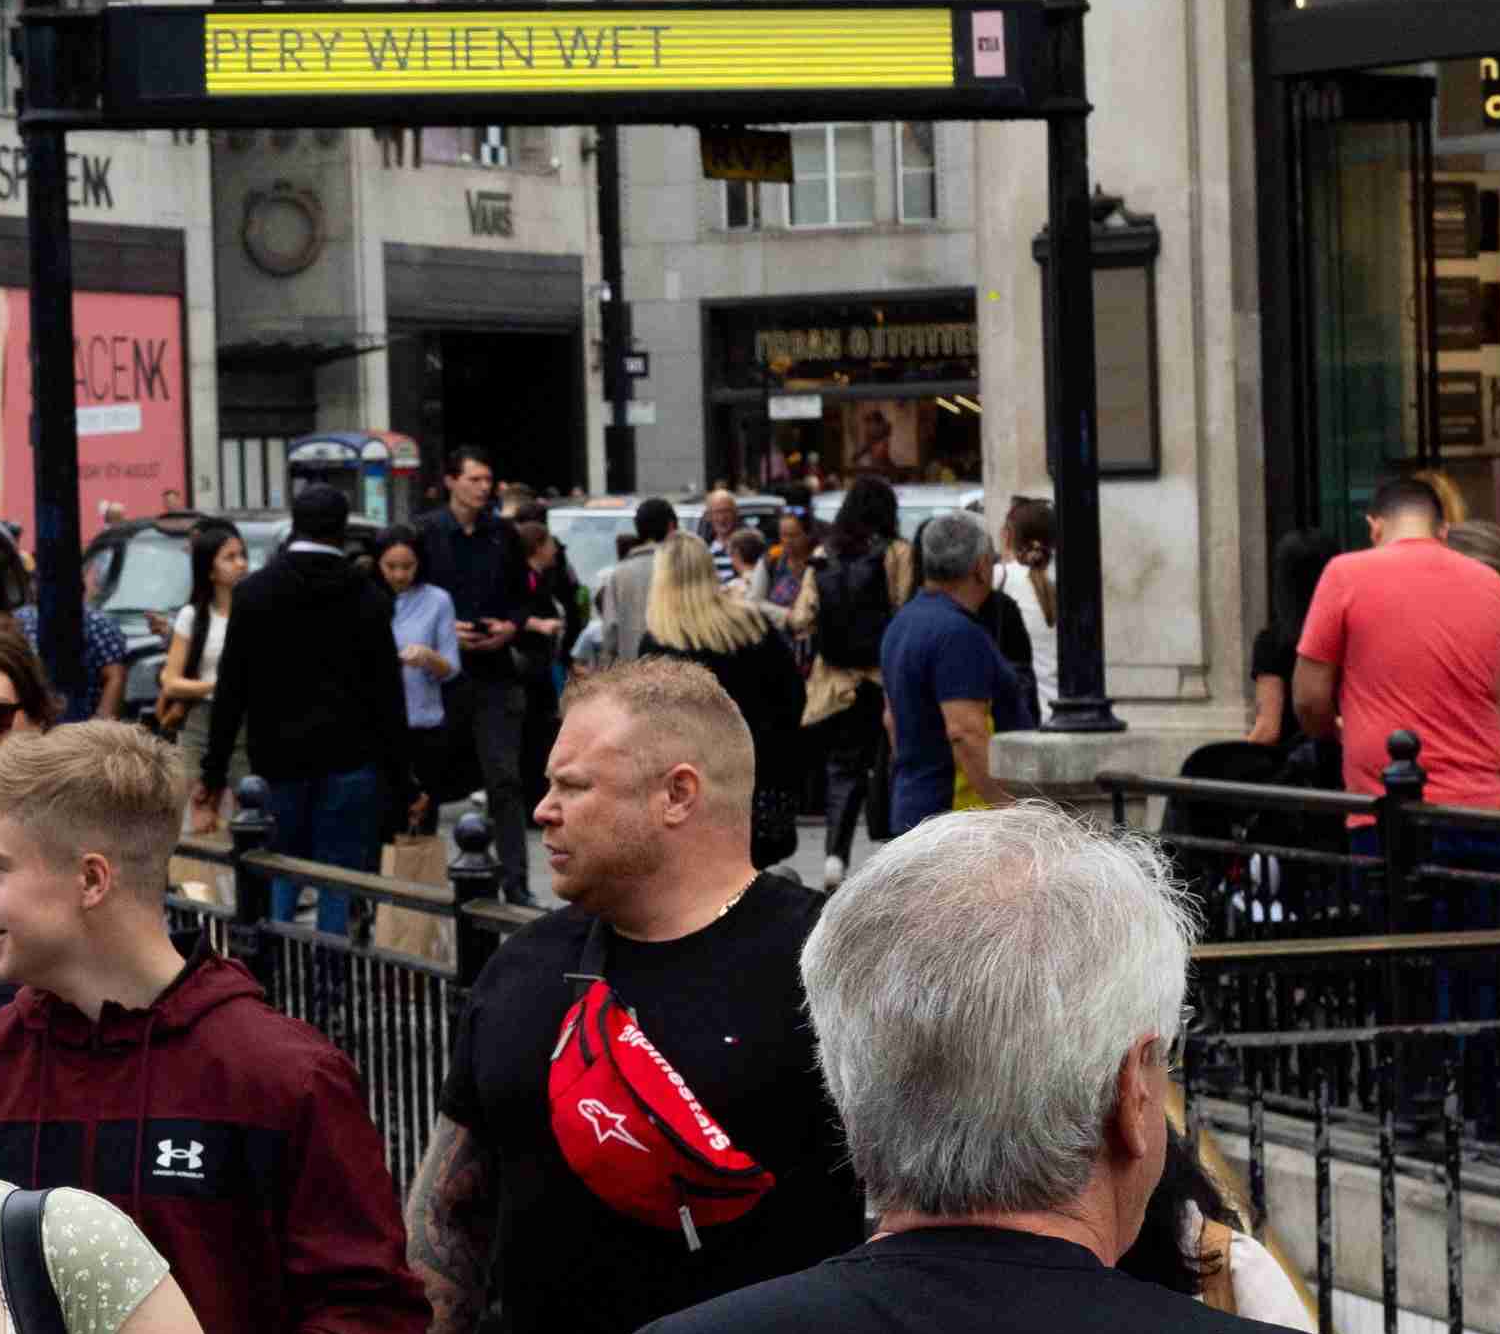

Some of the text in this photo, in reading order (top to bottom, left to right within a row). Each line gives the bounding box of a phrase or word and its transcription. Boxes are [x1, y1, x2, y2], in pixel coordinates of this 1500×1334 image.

[360, 25, 535, 72] WHEN
[553, 24, 672, 70] WET
[617, 1023, 731, 1151] alpinestars
